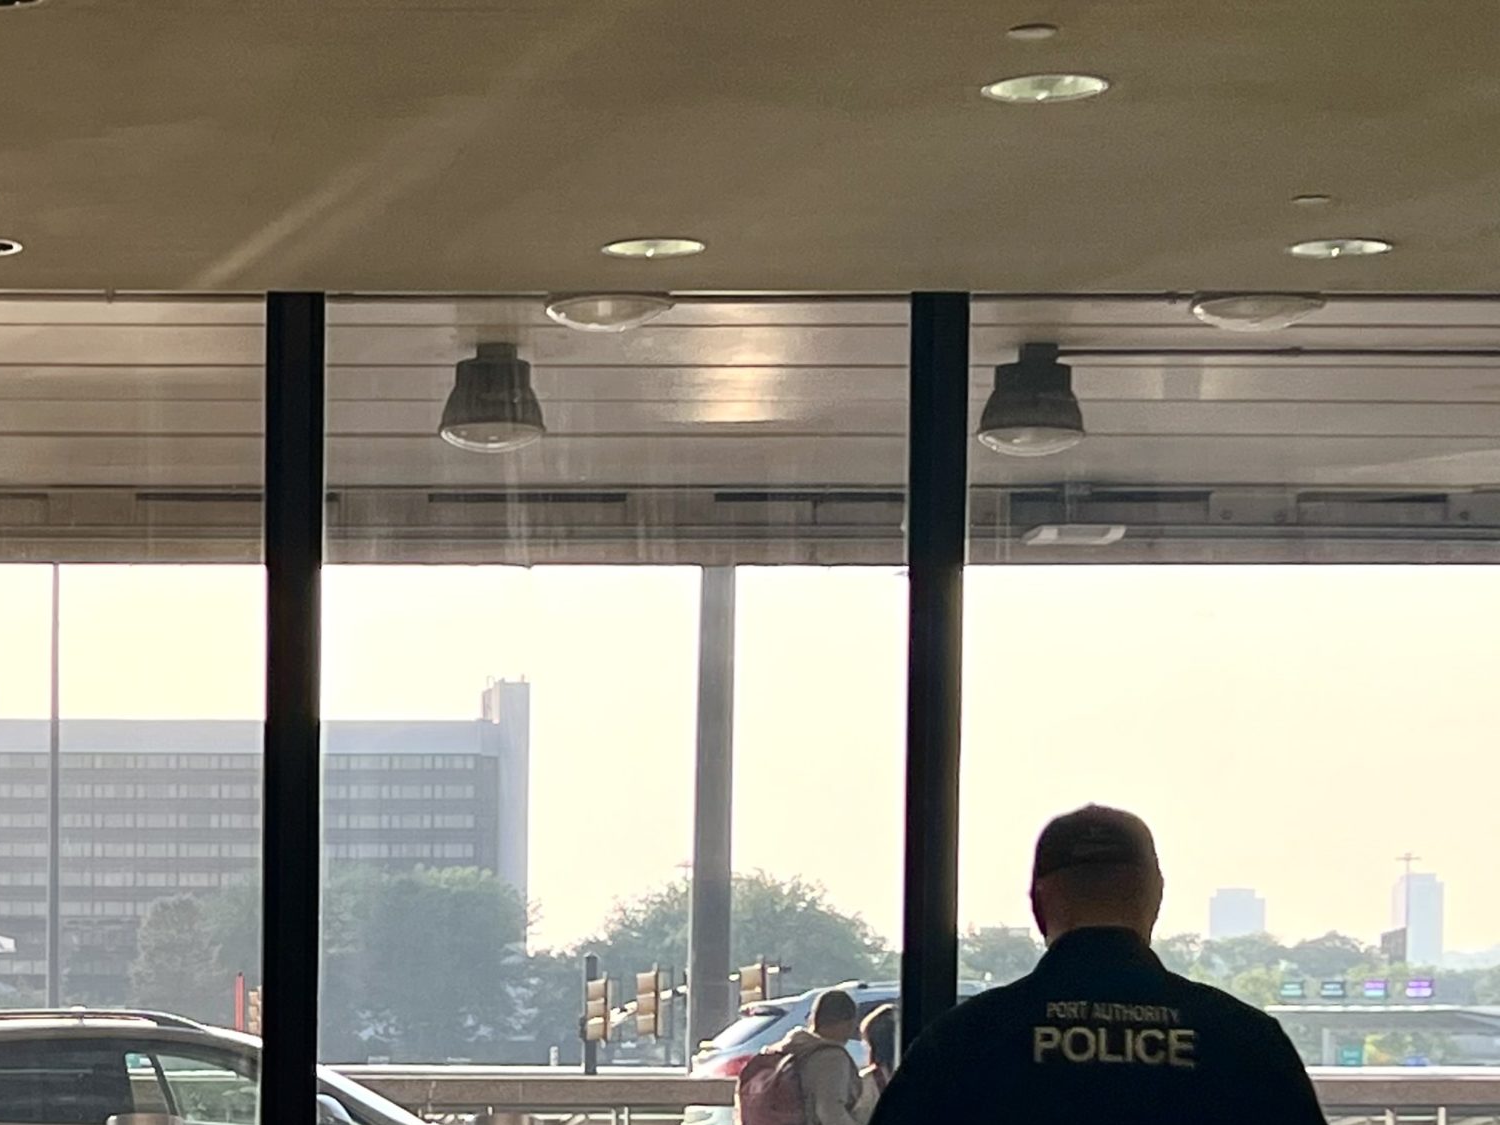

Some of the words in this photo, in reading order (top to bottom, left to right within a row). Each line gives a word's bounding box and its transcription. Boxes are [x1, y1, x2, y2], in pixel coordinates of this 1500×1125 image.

[1046, 1001, 1088, 1020] PORT
[1092, 1003, 1180, 1024] AUTHORITY
[1033, 1026, 1197, 1068] POLICE
